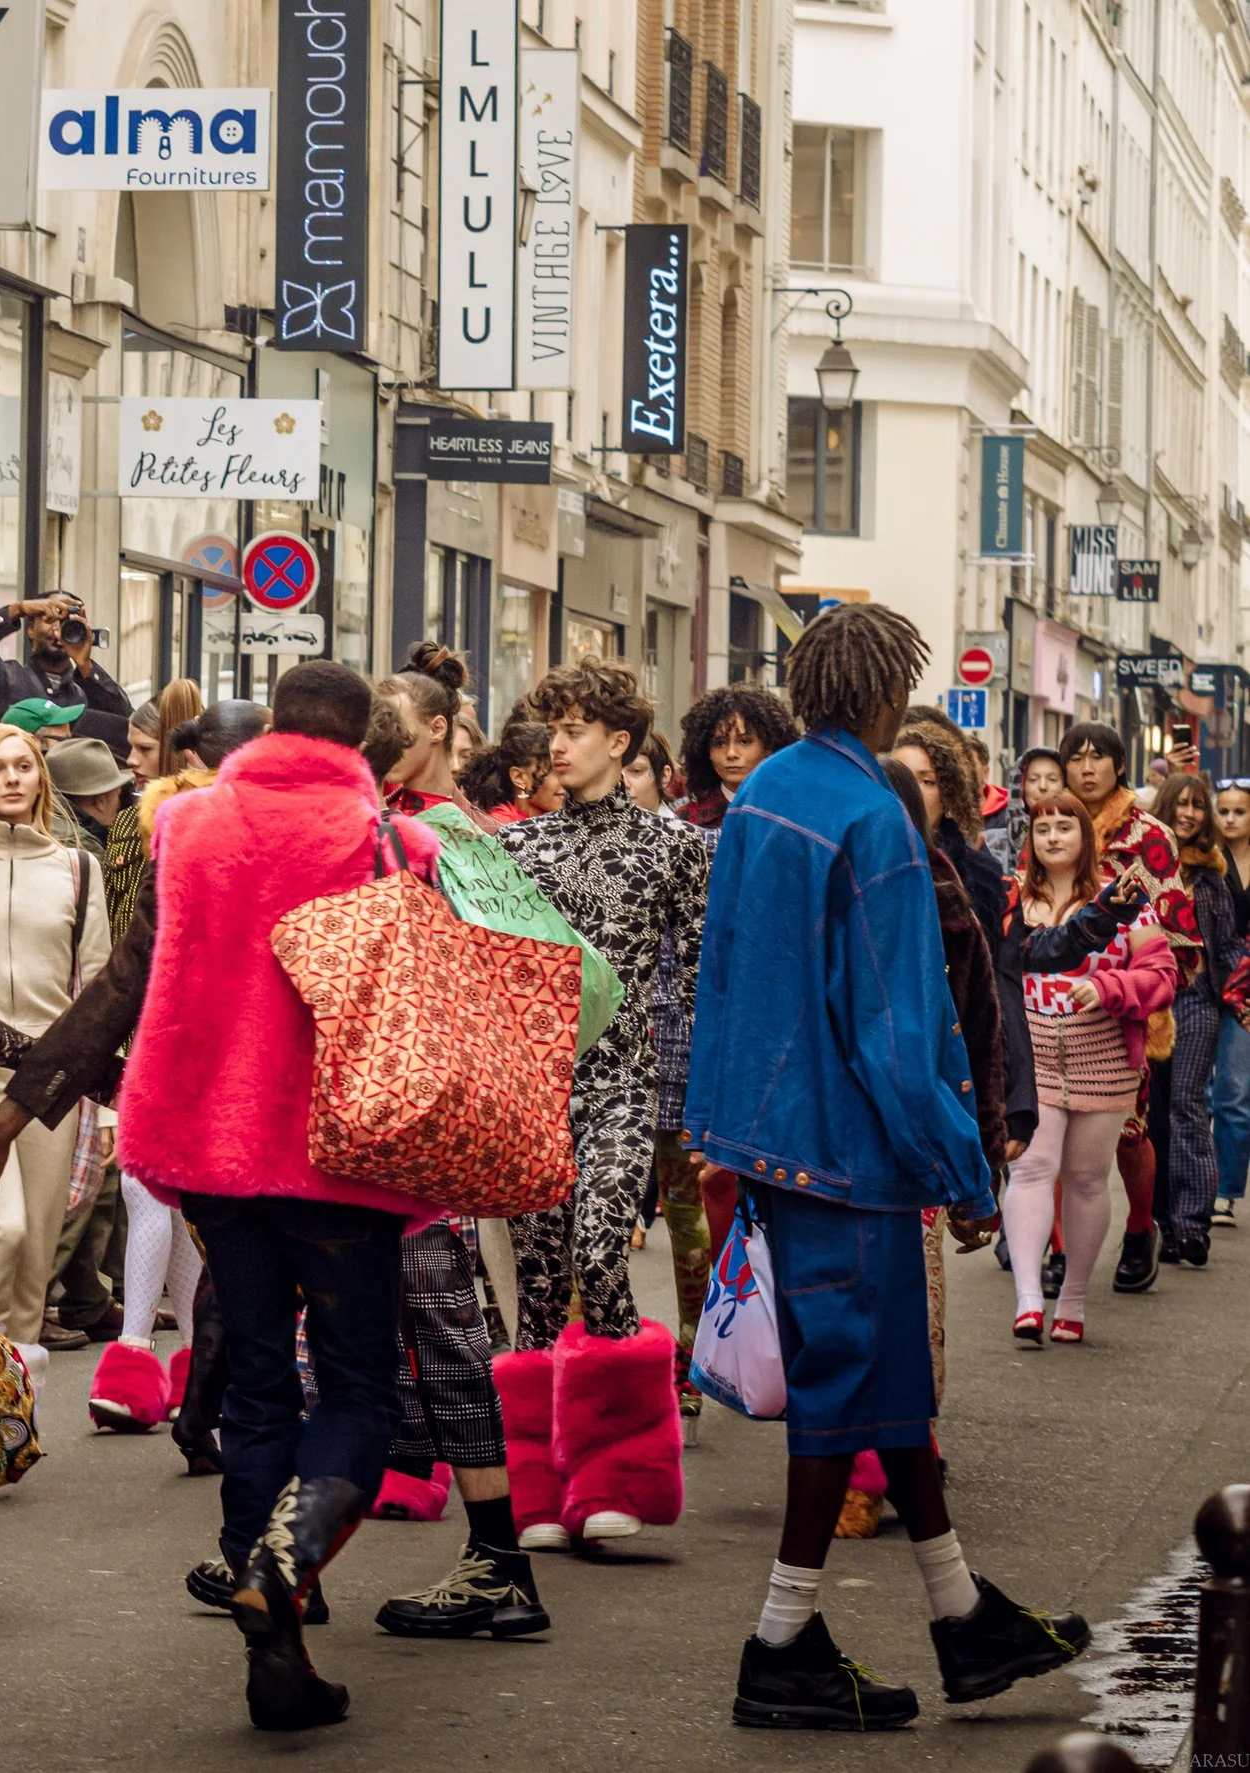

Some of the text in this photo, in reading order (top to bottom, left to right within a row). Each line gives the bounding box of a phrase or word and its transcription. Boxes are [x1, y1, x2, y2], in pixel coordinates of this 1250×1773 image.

[48, 95, 257, 160] alma
[126, 167, 257, 187] Fournitures
[458, 29, 499, 345] LMLULU
[532, 220, 570, 362] VINTAGE
[630, 233, 680, 446] Exetera...
[196, 406, 244, 447] Les
[430, 436, 550, 456] HEARTLESS JEANS
[130, 451, 217, 492] Petites
[219, 454, 306, 494] Fleurs
[477, 456, 502, 465] PARIS
[994, 444, 1010, 549] Climate House
[1071, 526, 1116, 555] MISS
[1070, 553, 1115, 595] JUNE
[1120, 562, 1158, 575] SAM
